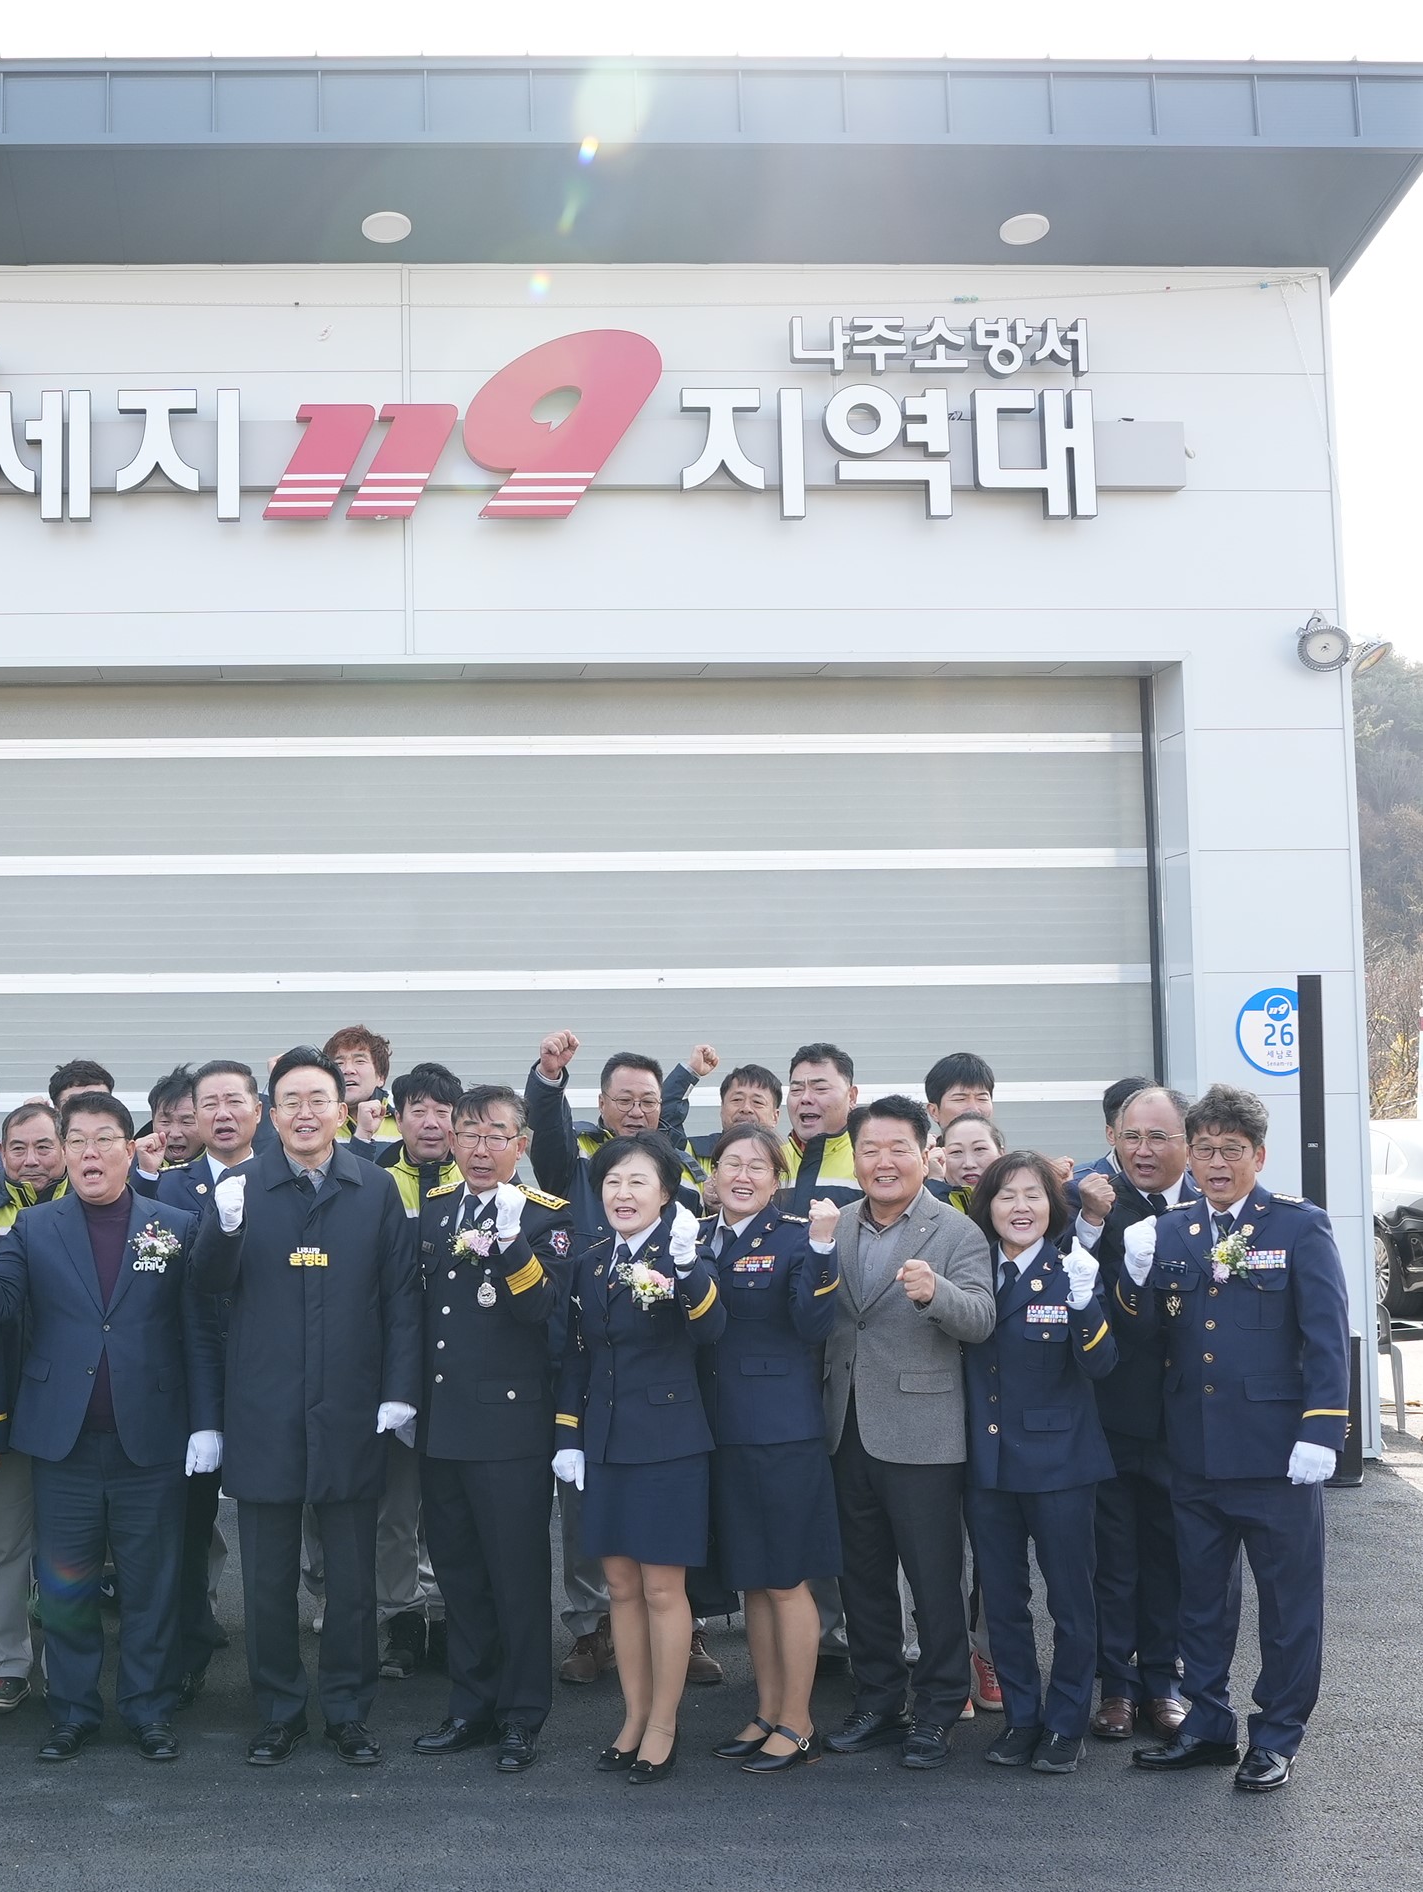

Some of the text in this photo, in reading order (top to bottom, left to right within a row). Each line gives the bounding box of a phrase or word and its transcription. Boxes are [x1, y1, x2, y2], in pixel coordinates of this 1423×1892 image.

[789, 316, 1089, 378] 나주소방서
[1268, 1003, 1289, 1015] 119
[1264, 1023, 1294, 1046] 26
[132, 1260, 167, 1274] 이재남
[289, 1253, 328, 1267] 윤병태
